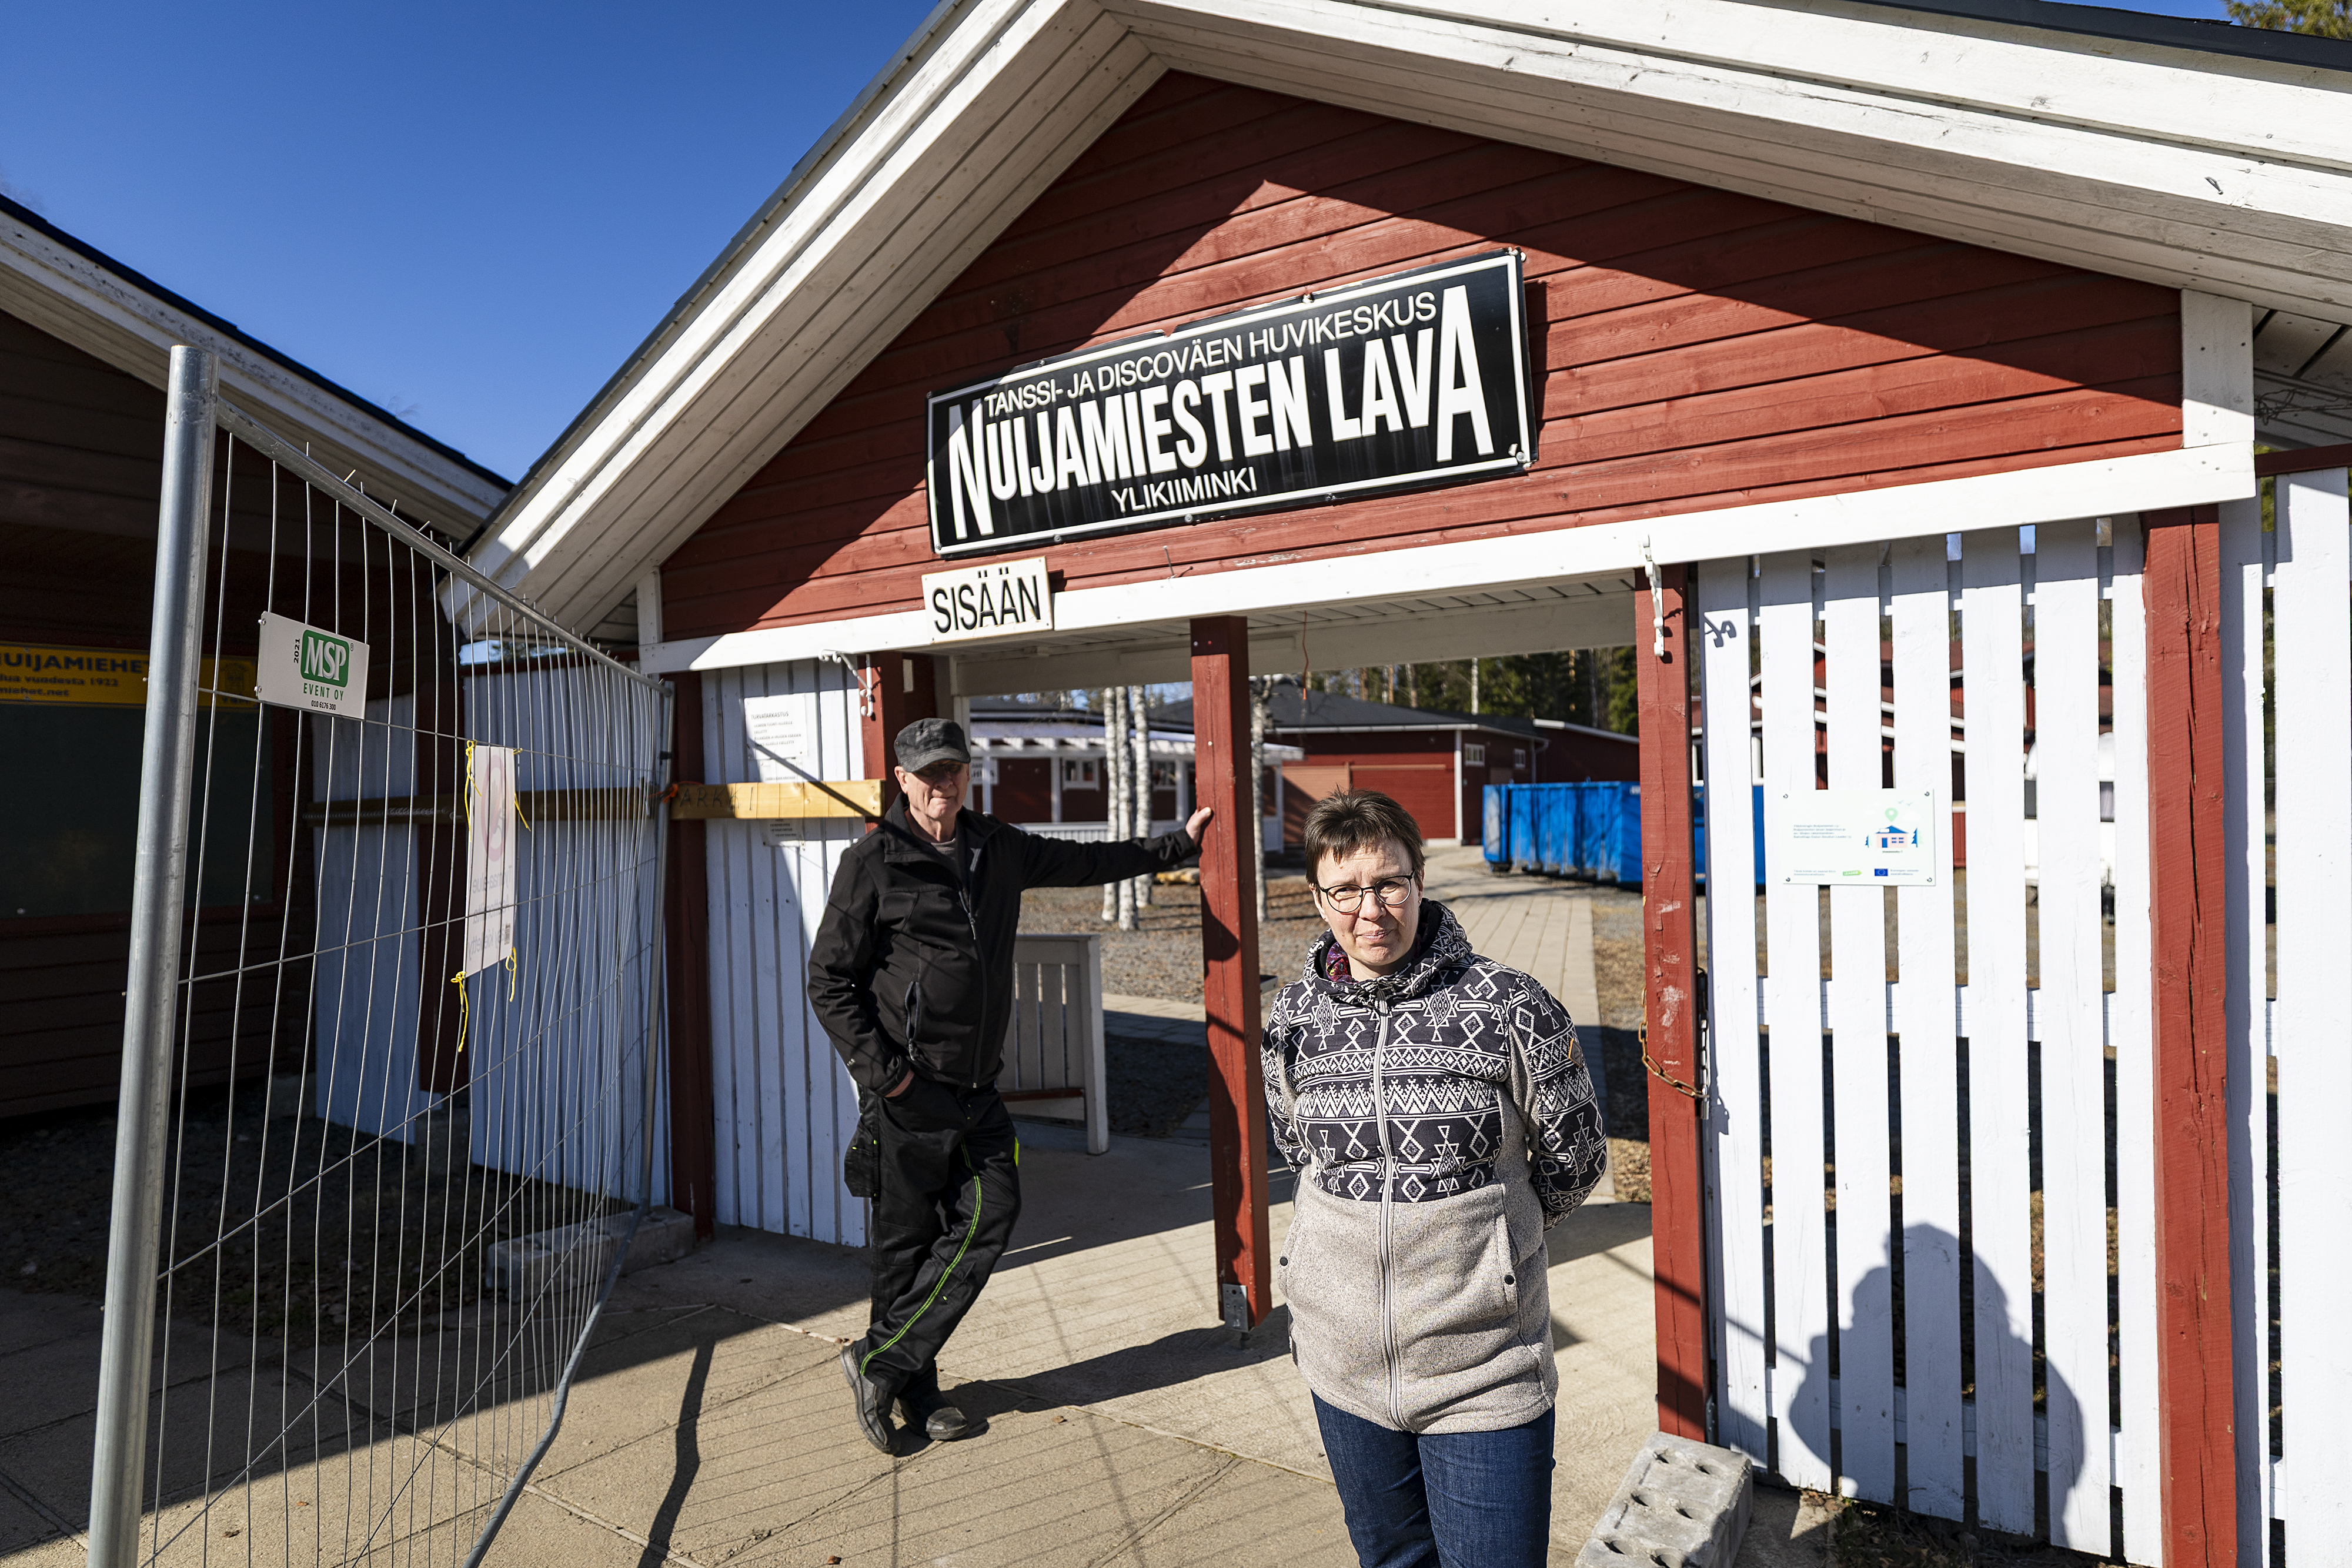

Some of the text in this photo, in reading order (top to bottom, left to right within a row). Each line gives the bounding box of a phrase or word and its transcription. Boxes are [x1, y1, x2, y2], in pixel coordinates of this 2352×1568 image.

[984, 292, 1436, 418] TANSSI- JA DISCOVÄEN HUVIKESKUS
[948, 285, 1495, 540] NUIJAMIESTEN LAVA
[1111, 466, 1257, 513] YLIKIIMINKI
[932, 566, 1041, 633] SISÄÄN
[0, 652, 149, 674] UIJAMIEHE
[303, 636, 347, 681] MSP
[303, 683, 344, 701] EVENT OY
[319, 701, 329, 710] 6176
[751, 711, 789, 720] TURVATARKASTUS
